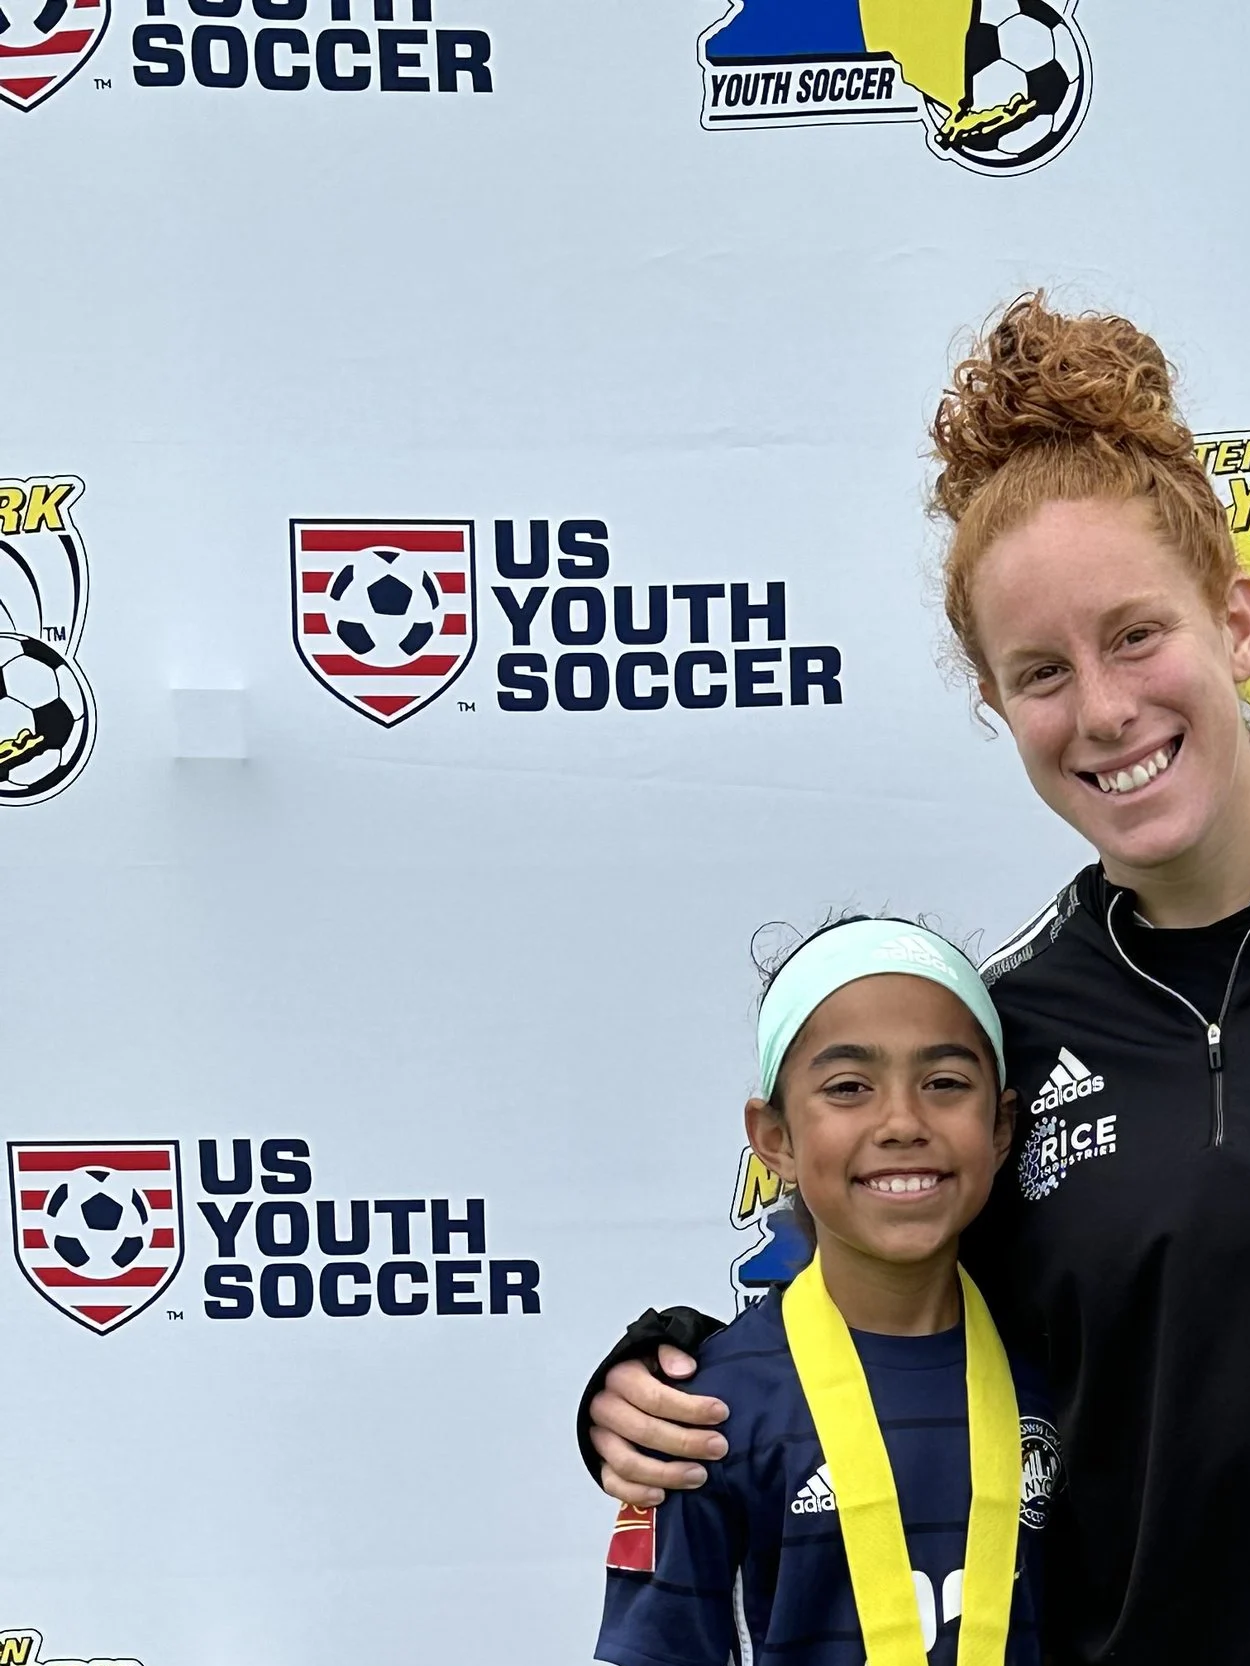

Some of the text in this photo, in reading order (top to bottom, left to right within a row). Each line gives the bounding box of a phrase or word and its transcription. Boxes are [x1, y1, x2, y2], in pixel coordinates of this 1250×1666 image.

[132, 23, 493, 92] SOCCER
[711, 67, 895, 107] YOUTH SOCCER
[494, 520, 609, 580] US
[492, 581, 786, 646] YOUTH
[497, 646, 842, 712] SOCCER
[1030, 1075, 1105, 1115] adidas
[199, 1138, 312, 1195] US
[196, 1198, 486, 1258] YOUTH
[204, 1259, 541, 1319] SOCCER
